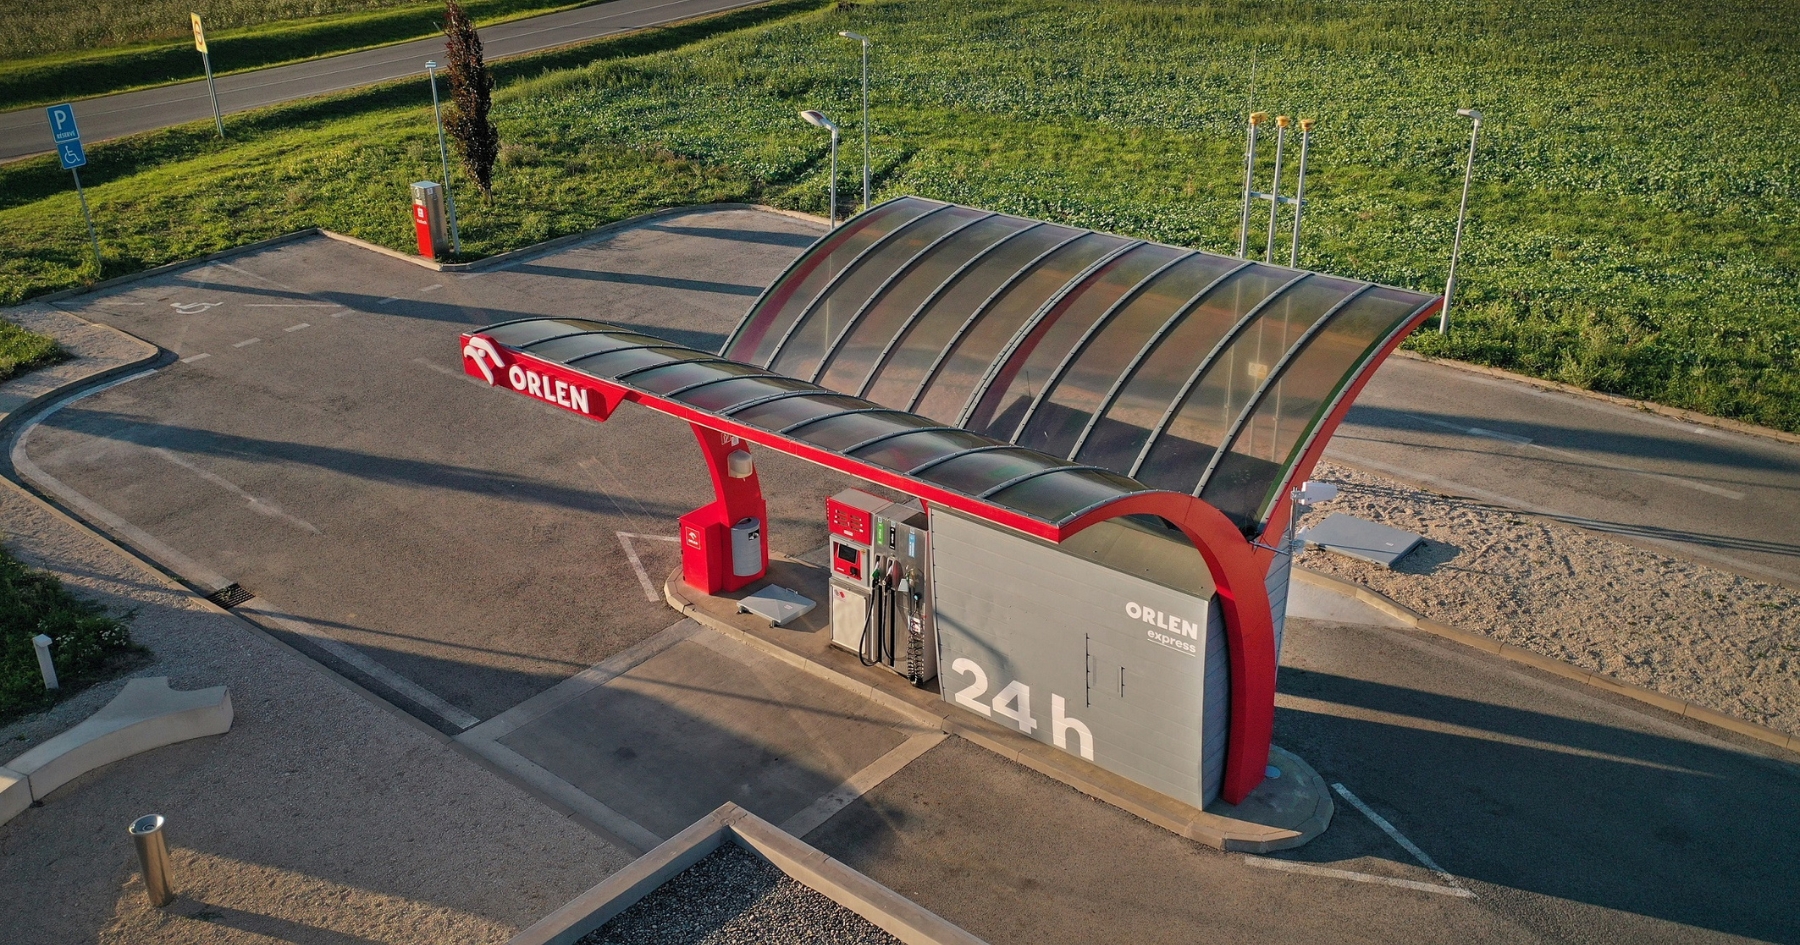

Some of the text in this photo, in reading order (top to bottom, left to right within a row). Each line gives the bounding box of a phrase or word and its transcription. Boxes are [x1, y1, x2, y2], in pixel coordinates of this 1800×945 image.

[54, 110, 67, 130] P
[509, 365, 590, 414] ORLEN
[1125, 601, 1198, 640] ORLEN
[1147, 630, 1196, 653] express
